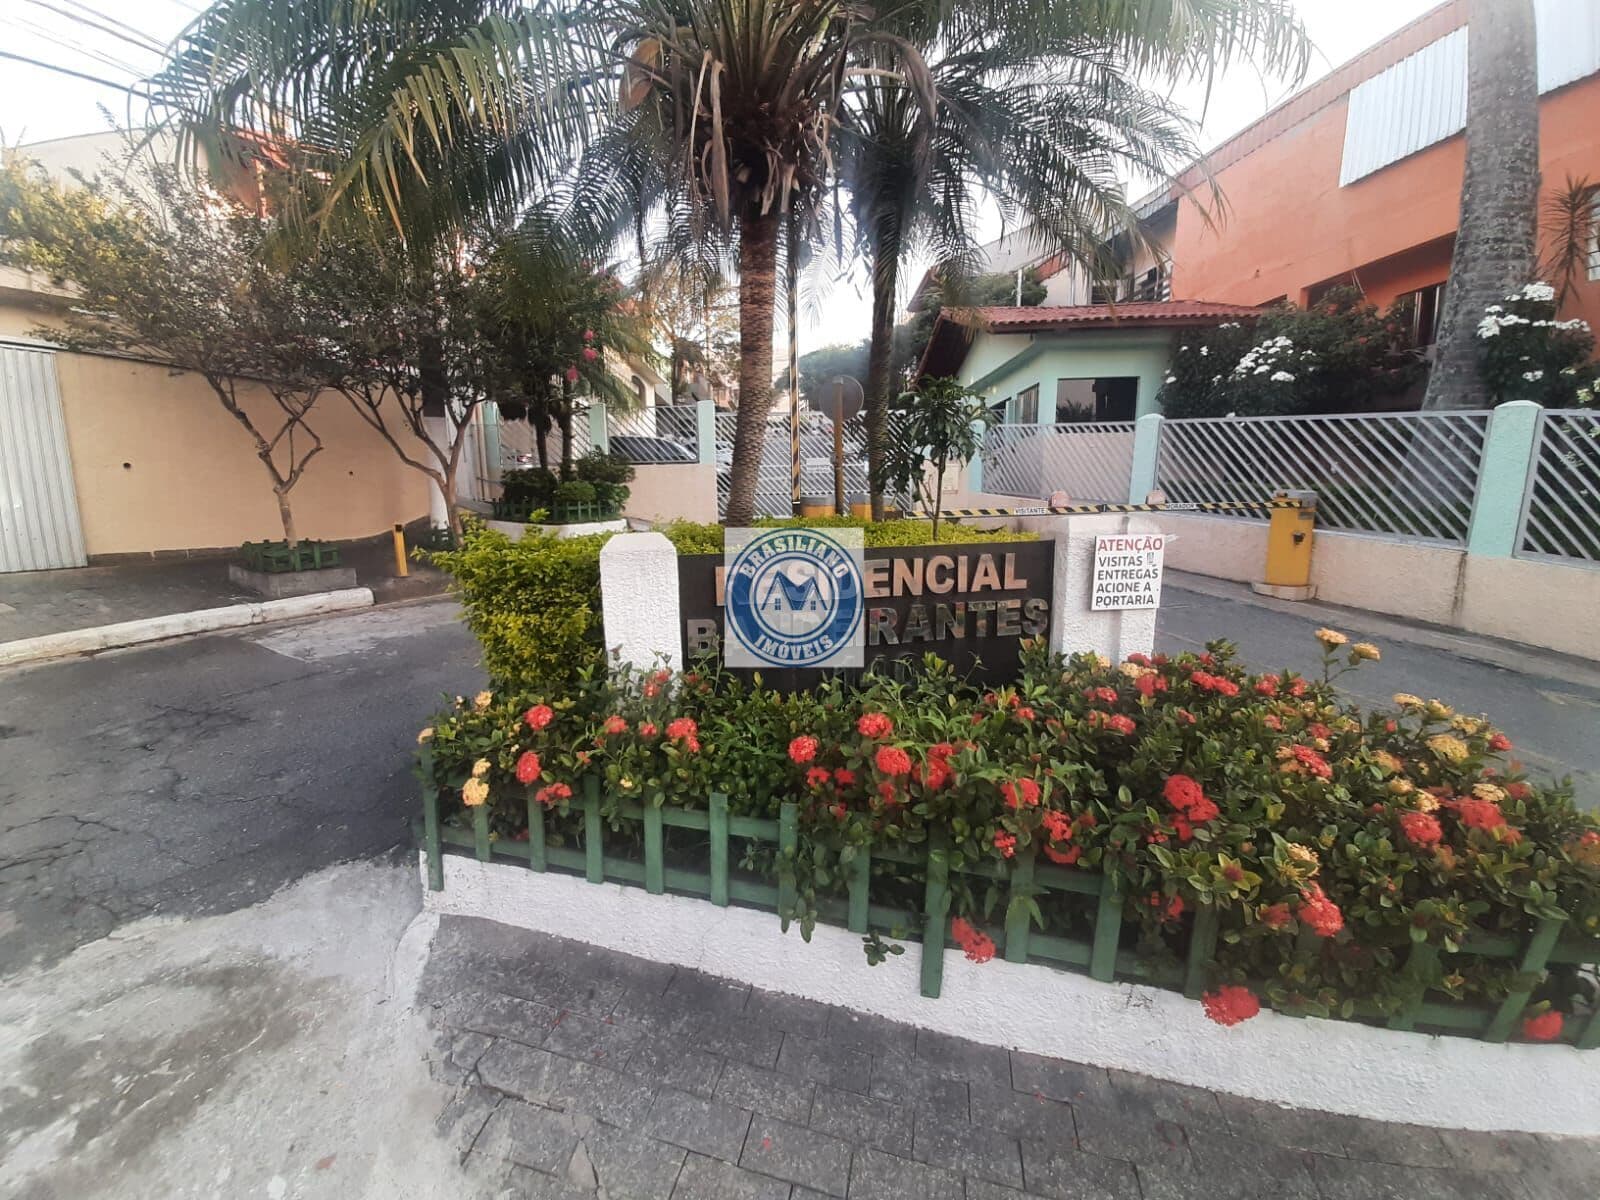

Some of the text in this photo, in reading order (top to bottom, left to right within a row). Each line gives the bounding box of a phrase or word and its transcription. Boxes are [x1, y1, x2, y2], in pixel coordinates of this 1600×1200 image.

[1015, 507, 1046, 515] VISITANTE
[1098, 536, 1163, 553] ATENÇÃO
[1099, 556, 1143, 567] VISITAS
[715, 552, 1027, 606] SENCIAL
[1098, 569, 1158, 580] ENTREGAS
[1096, 582, 1152, 593] ACIONE A
[1095, 595, 1154, 606] PORTARIA
[687, 599, 1049, 659] BRANTES
